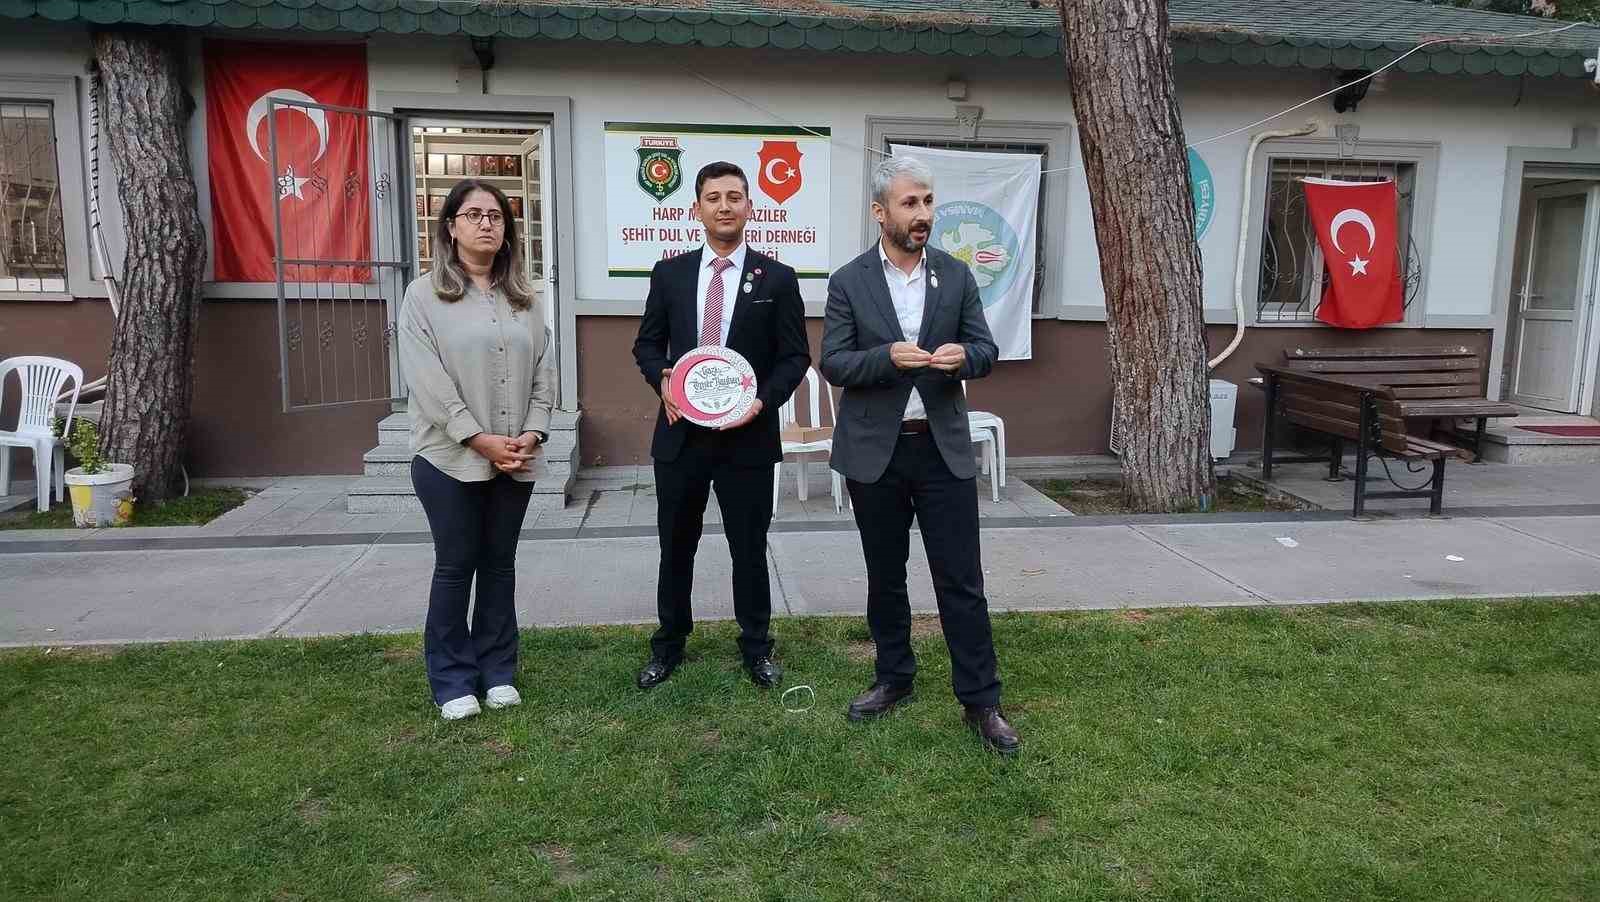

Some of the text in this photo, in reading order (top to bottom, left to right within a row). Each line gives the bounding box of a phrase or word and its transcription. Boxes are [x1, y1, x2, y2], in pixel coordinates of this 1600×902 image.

[653, 207, 684, 221] HARP
[749, 205, 787, 222] AZİLER
[1195, 179, 1209, 233] EDİYESİ
[622, 224, 655, 245] ŞEHİT
[659, 227, 683, 241] DUL
[686, 228, 701, 242] VE
[766, 226, 816, 243] DERNEĞİ
